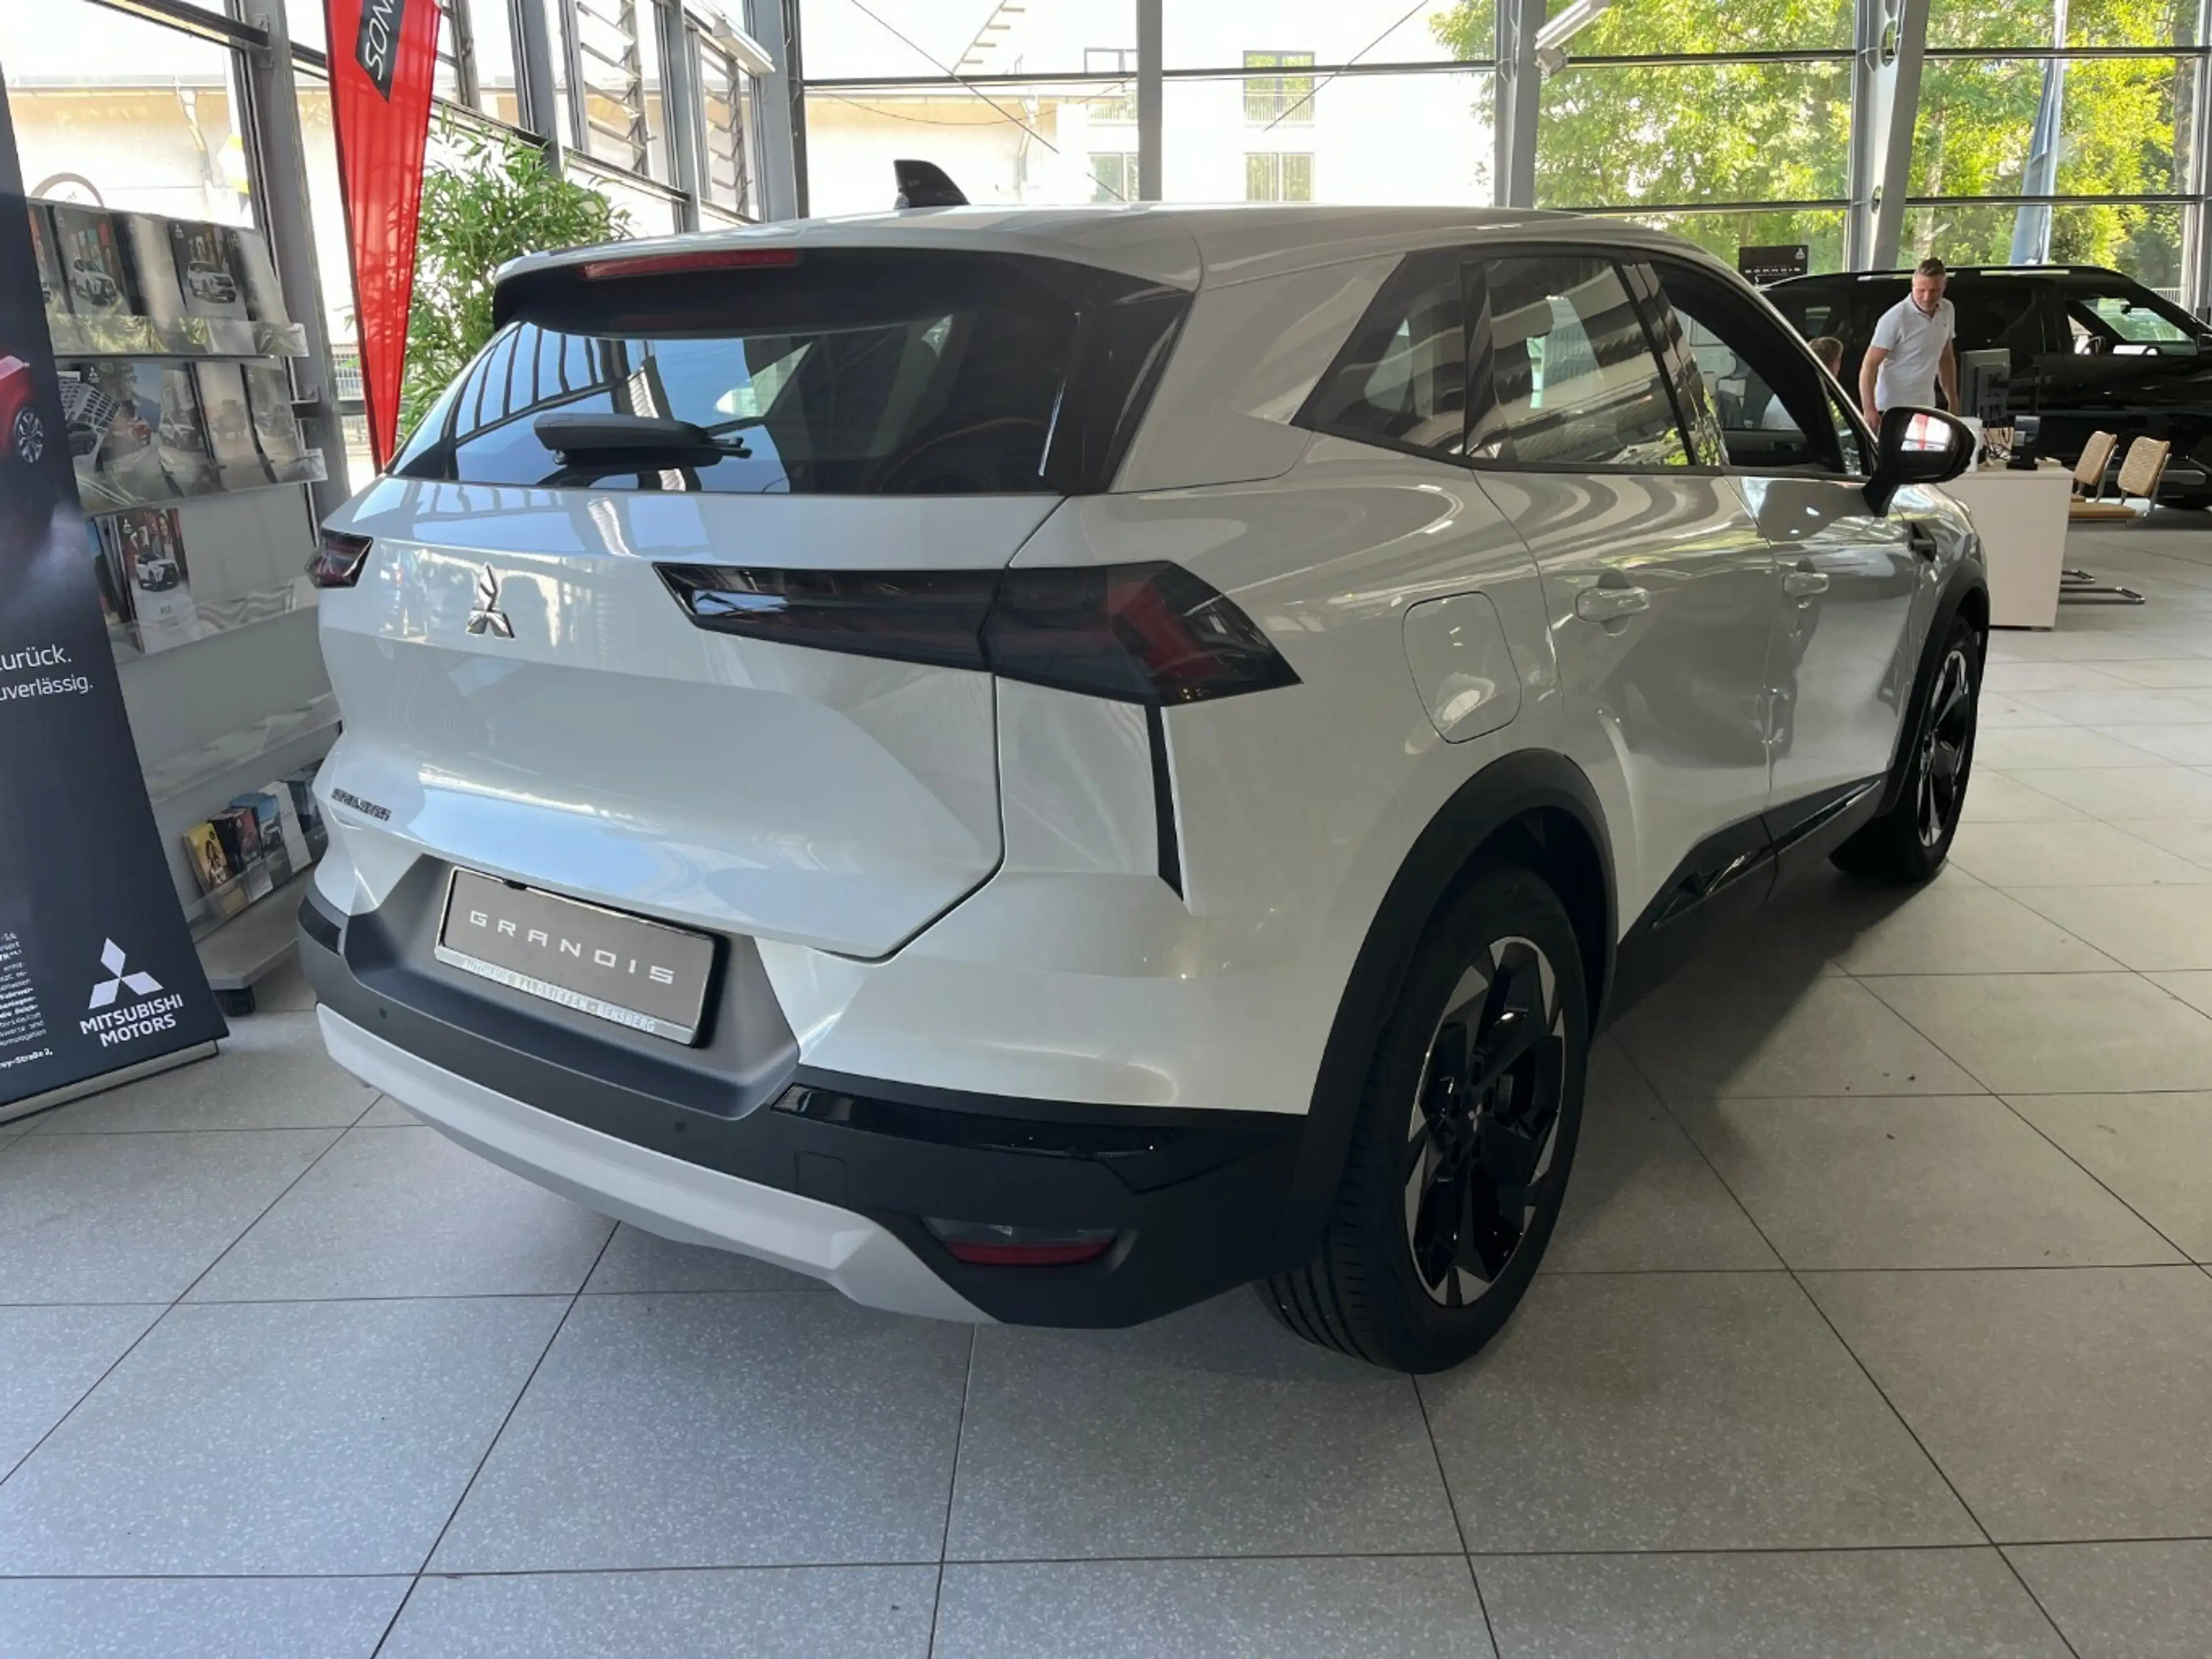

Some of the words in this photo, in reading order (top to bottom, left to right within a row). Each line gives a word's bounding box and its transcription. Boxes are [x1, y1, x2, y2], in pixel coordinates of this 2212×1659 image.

[365, 0, 394, 81] SON
[0, 643, 72, 672] urück.
[469, 910, 675, 984] GRANDIS
[80, 993, 184, 1035] MITSUBISHI
[99, 1014, 176, 1048] MOTORS
[597, 1002, 656, 1033] BENSBERG
